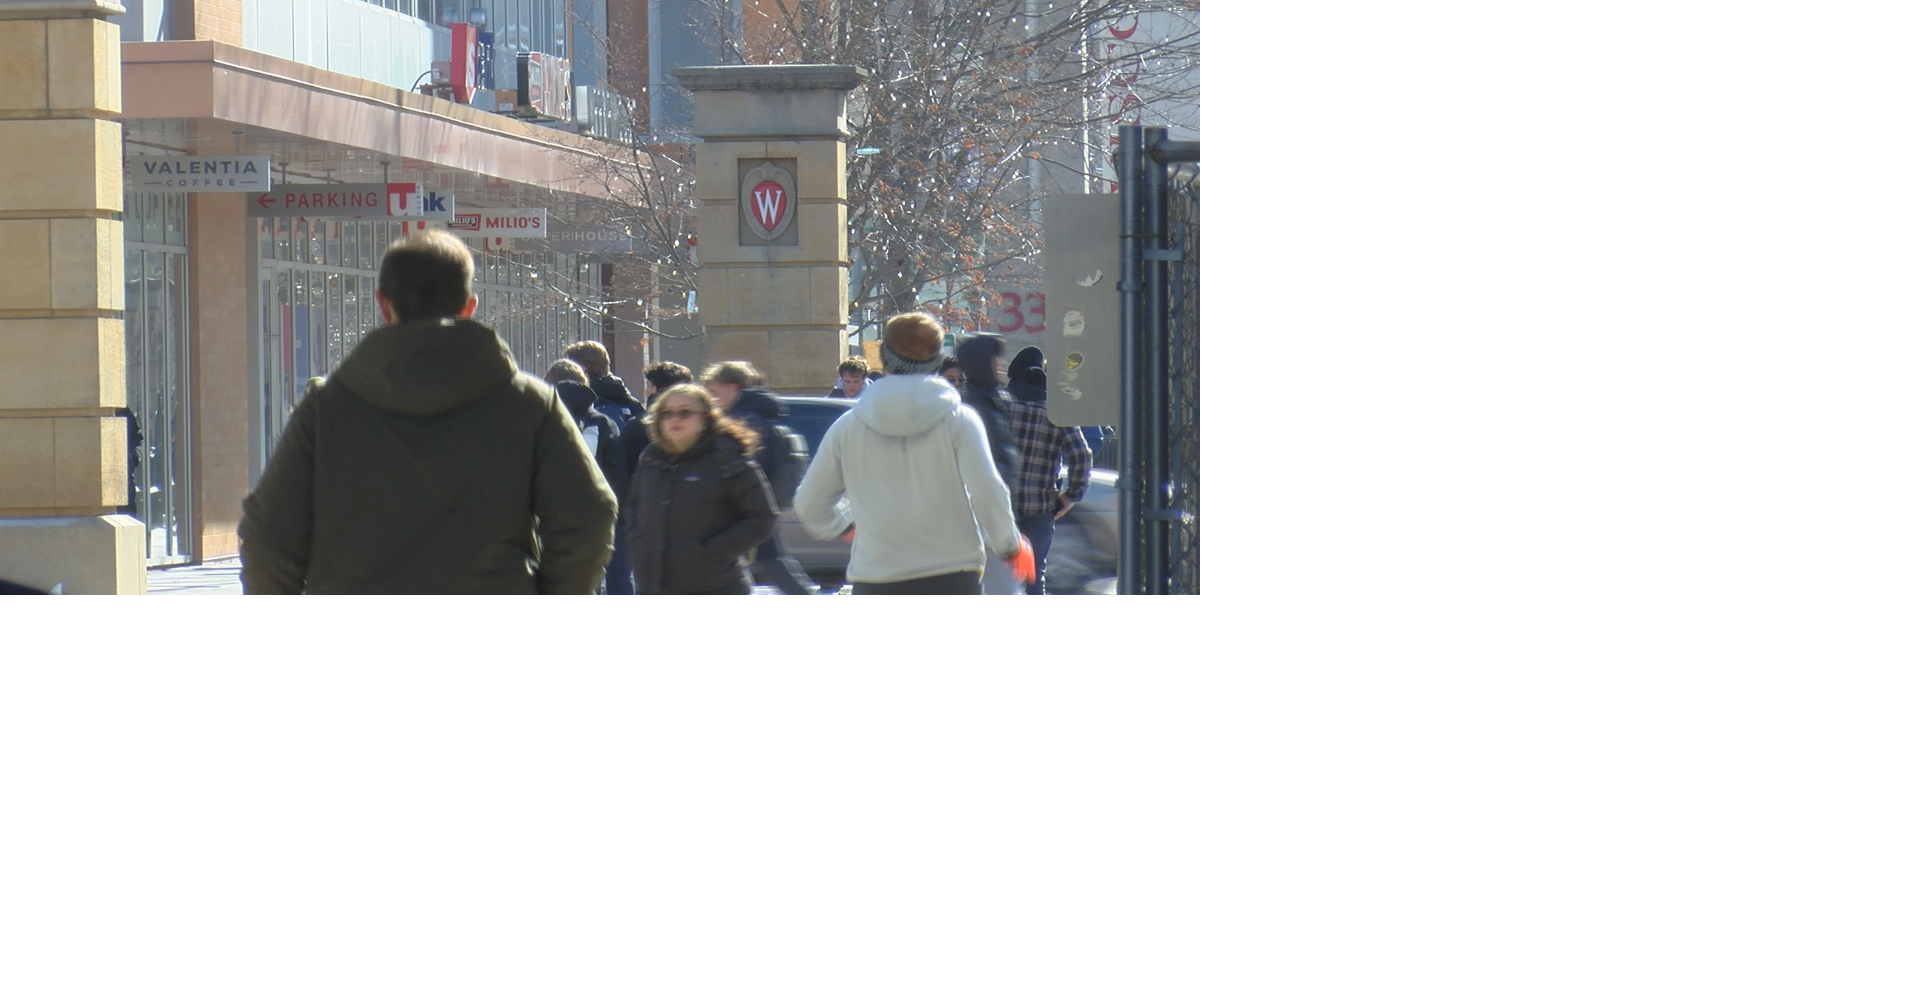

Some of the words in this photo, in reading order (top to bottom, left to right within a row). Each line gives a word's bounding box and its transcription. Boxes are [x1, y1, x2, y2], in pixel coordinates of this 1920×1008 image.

[143, 161, 258, 174] VALENTIA
[166, 179, 236, 187] COFFEE
[285, 192, 378, 208] PARKING
[754, 189, 783, 225] W
[485, 217, 540, 229] MILIO'S
